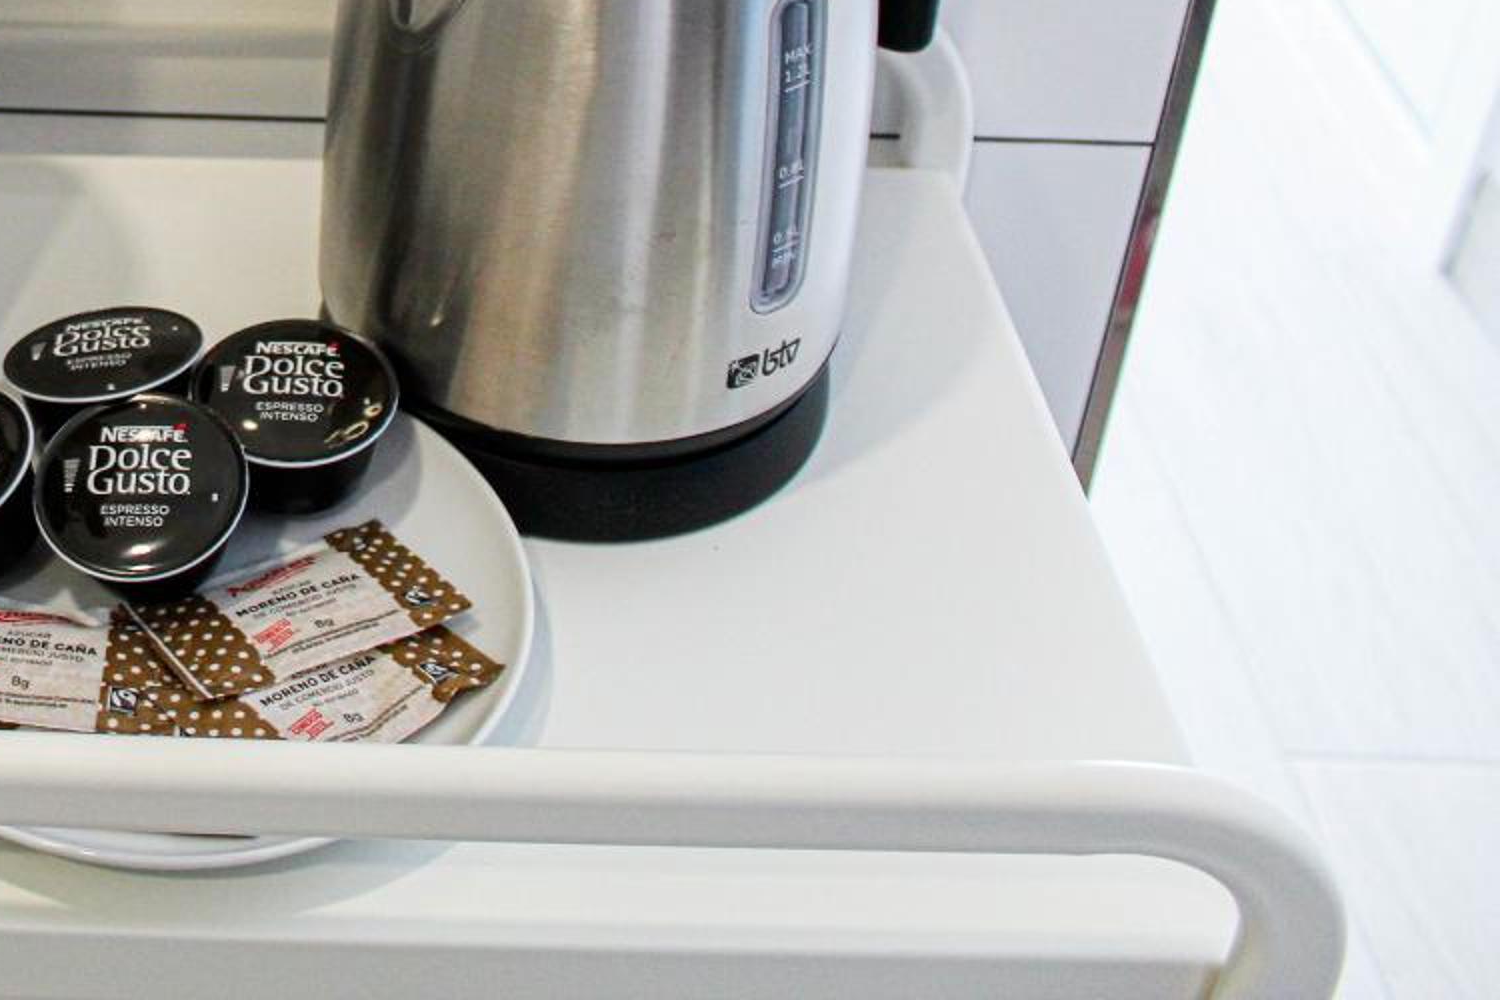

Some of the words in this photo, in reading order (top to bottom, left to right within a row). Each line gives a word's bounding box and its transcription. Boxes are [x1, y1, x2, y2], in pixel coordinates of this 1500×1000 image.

[53, 336, 151, 357] Gusto
[54, 325, 151, 347] Dolce
[244, 355, 345, 379] Dolce
[242, 373, 344, 398] Gusto
[256, 401, 324, 413] ESPRESSO
[260, 411, 318, 423] INTENSO
[88, 443, 193, 471] Dolce
[87, 466, 191, 496] Gusto
[100, 504, 170, 516] ESPRESSO
[103, 516, 164, 527] INTENSO
[235, 591, 298, 618] MORENO
[300, 585, 318, 596] DE
[321, 572, 361, 589] CAÑA
[314, 617, 335, 629] 8g
[29, 639, 51, 650] DE
[54, 642, 98, 656] CAÑA
[10, 674, 31, 690] 8g
[259, 677, 319, 707] MORENO
[319, 669, 339, 683] DE
[339, 654, 377, 676] CAÑA
